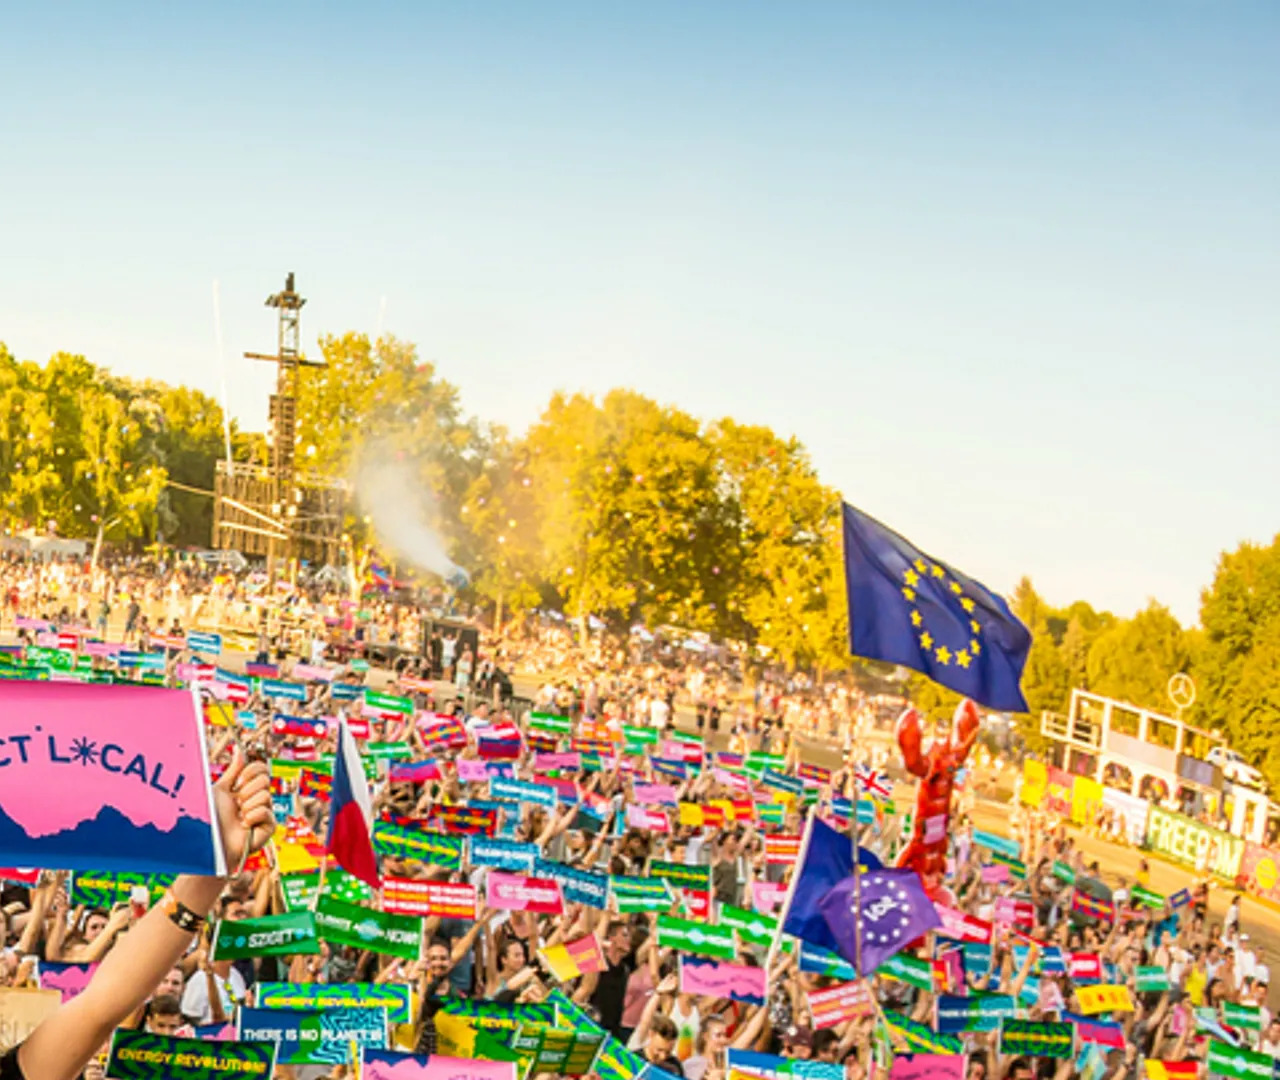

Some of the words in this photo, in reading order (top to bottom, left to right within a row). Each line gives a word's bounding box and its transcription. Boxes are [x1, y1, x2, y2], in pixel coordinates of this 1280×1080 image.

[243, 1027, 279, 1041] THERE
[281, 1027, 297, 1041] IS
[300, 1027, 319, 1041] NO
[320, 1028, 366, 1042] PLANET
[117, 1047, 171, 1065] ENERGY
